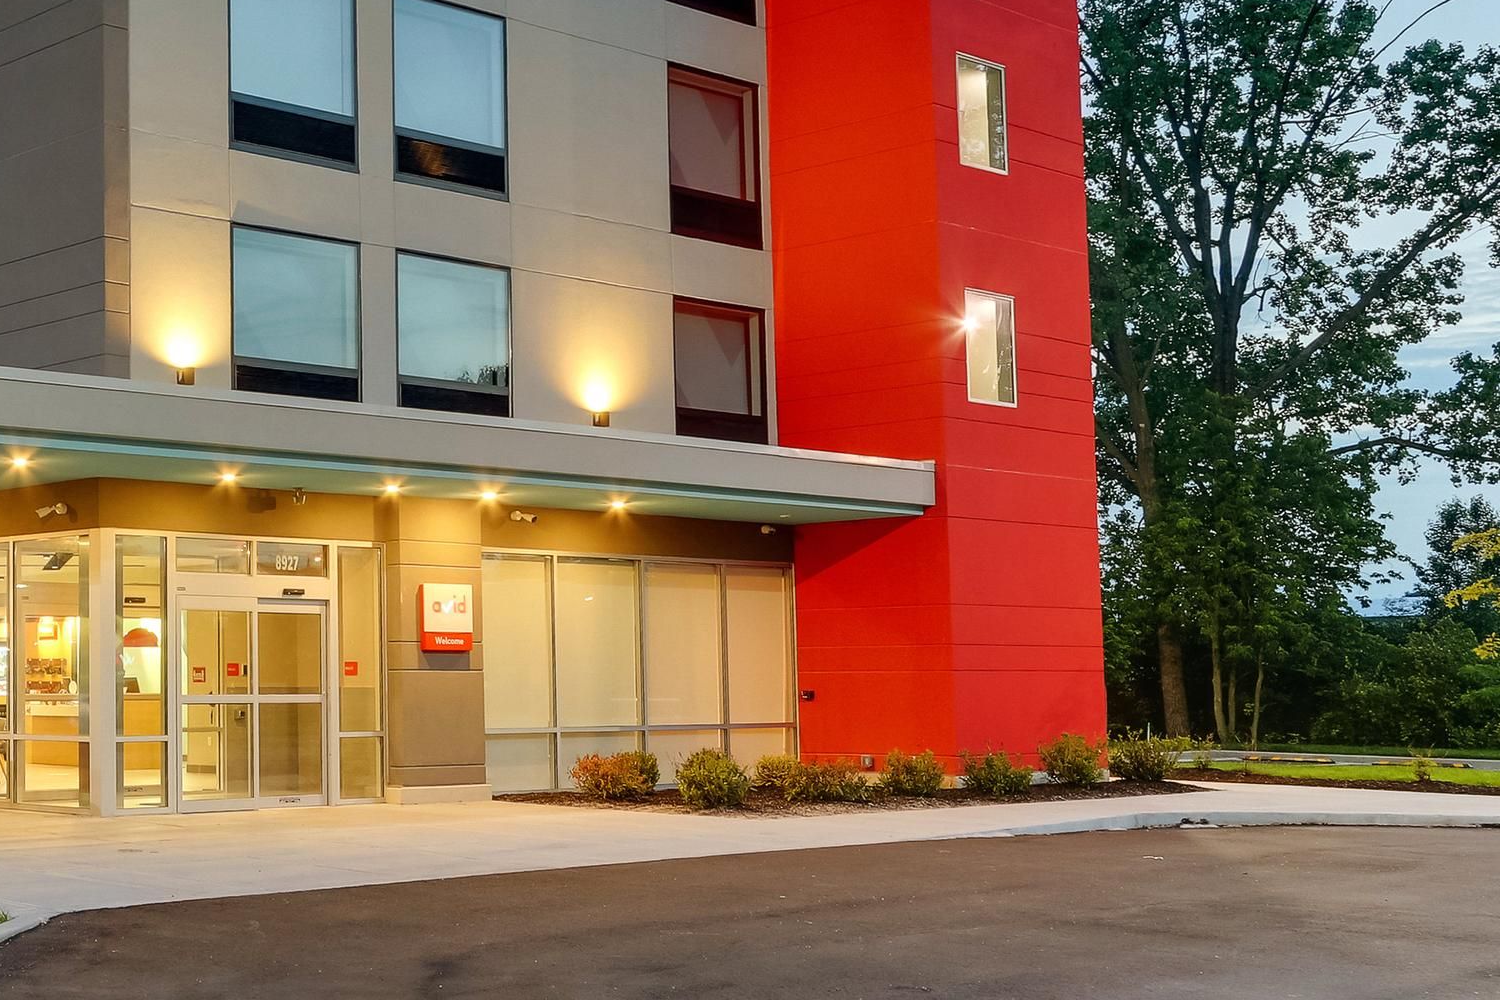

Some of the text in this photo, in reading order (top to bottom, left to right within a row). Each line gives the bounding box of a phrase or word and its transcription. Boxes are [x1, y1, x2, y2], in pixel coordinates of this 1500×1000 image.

[275, 555, 299, 571] 8927
[432, 594, 467, 614] avid
[435, 636, 465, 646] Welcome
